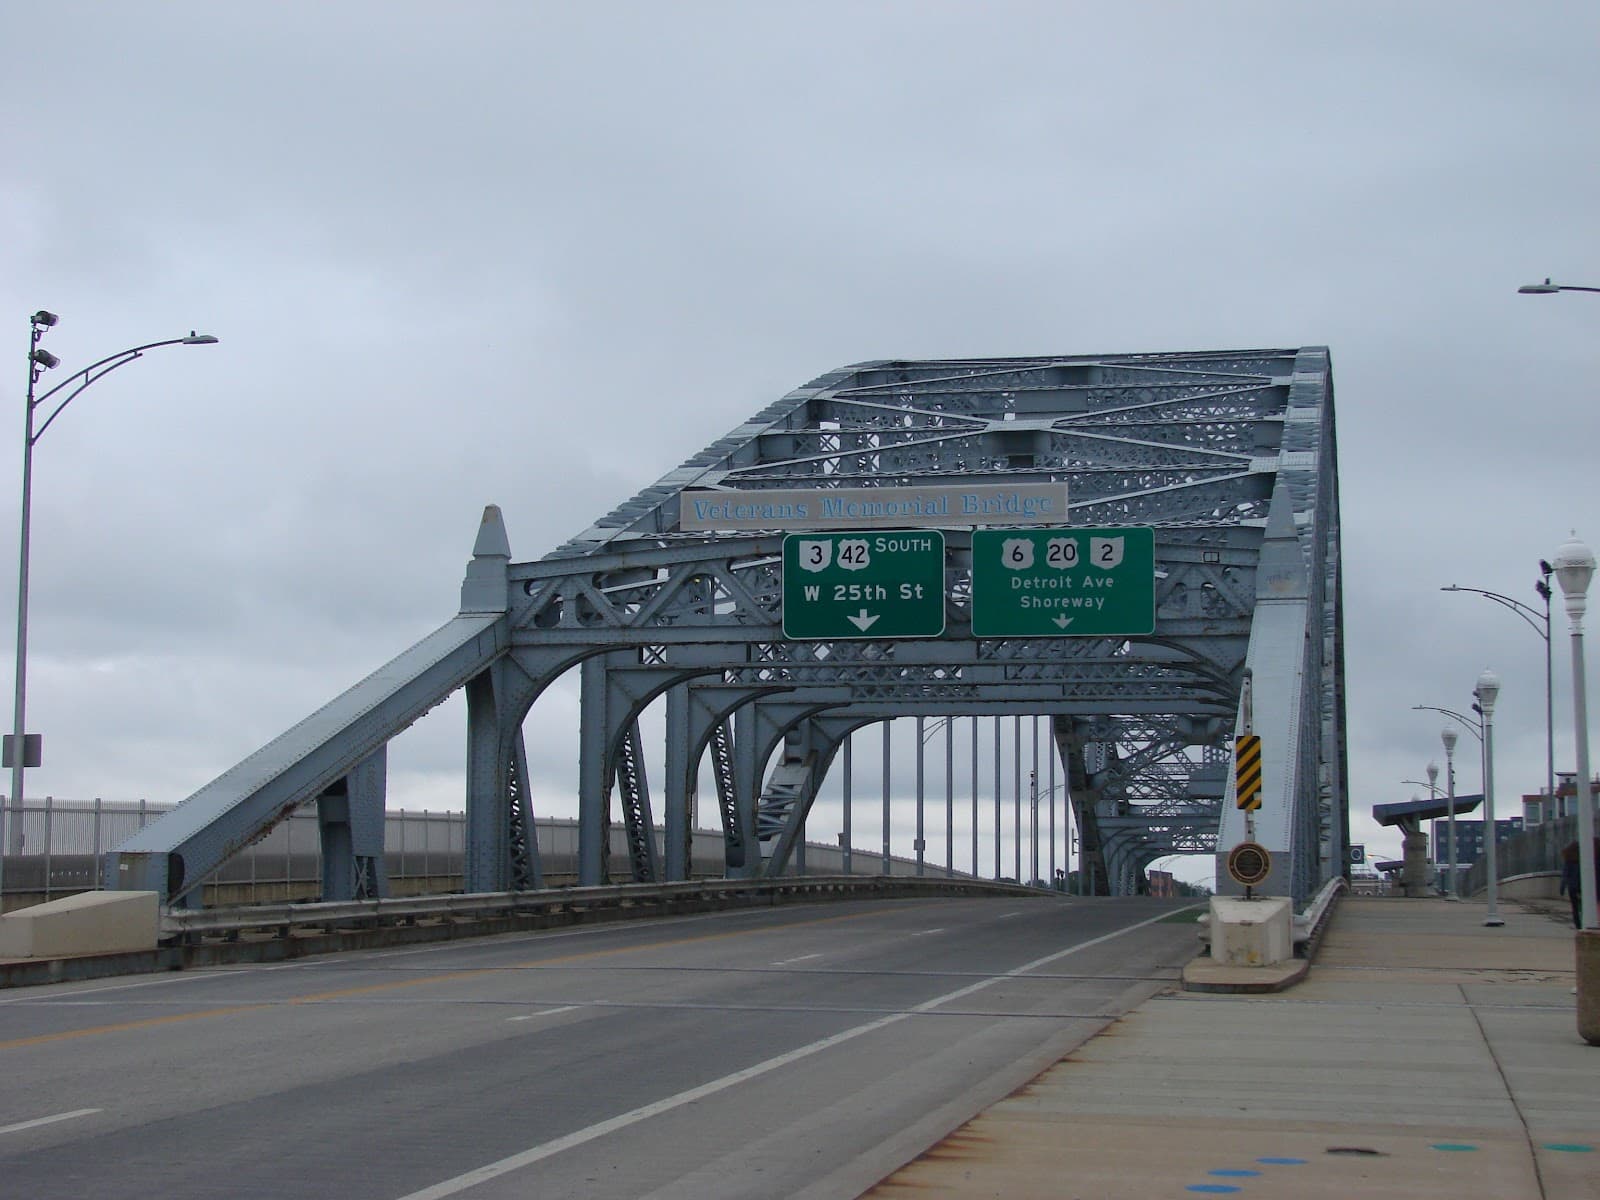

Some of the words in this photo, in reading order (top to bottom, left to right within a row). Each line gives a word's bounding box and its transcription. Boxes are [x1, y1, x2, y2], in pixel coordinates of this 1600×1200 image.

[693, 498, 809, 521] Veterans
[819, 494, 949, 519] Memorial
[960, 491, 1053, 518] Bridge
[810, 545, 823, 565] 3
[841, 545, 866, 564] 42
[875, 537, 931, 553] SOUTH
[1012, 545, 1024, 562] 6
[1048, 543, 1076, 562] 20
[1101, 543, 1114, 562] 2
[1011, 575, 1072, 590] Detroit
[1082, 575, 1114, 588] Ave
[804, 585, 820, 602] W
[833, 584, 887, 601] 25th
[899, 583, 923, 600] St
[1020, 595, 1105, 611] Shoreway
